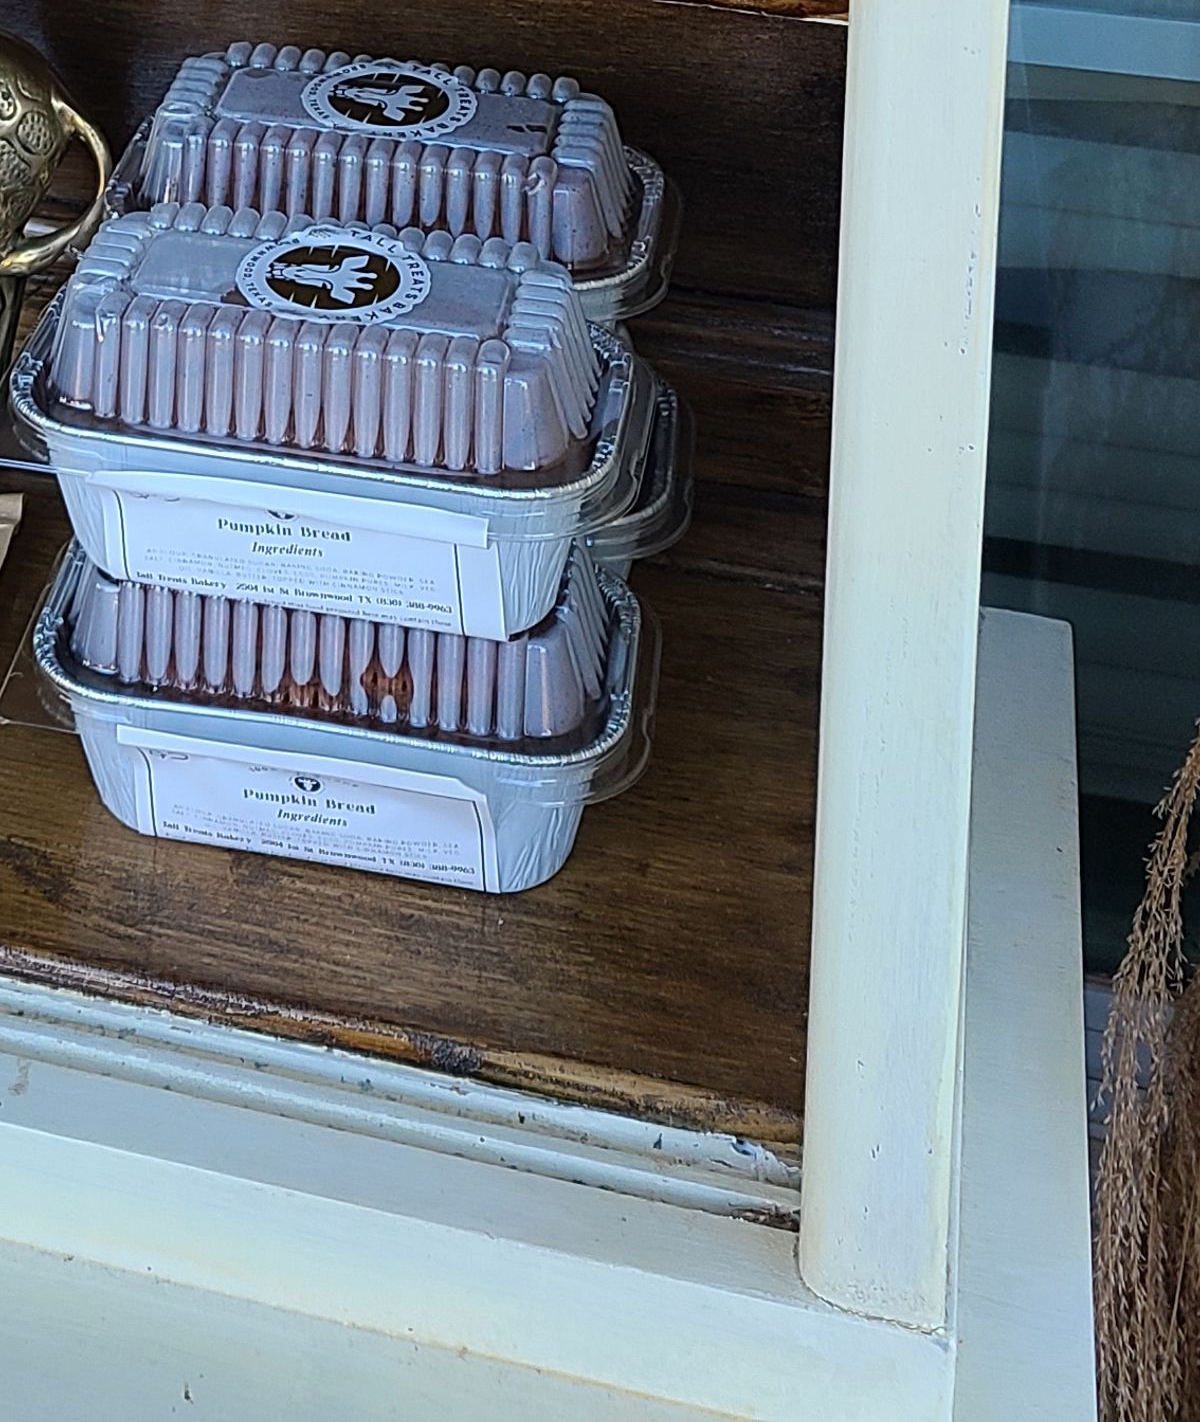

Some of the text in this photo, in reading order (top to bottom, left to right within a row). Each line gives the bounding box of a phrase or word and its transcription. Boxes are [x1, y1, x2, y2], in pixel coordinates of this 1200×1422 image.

[412, 65, 453, 86] TALL
[350, 230, 397, 254] TALL
[401, 255, 425, 300] TREATS
[245, 282, 273, 307] TEXAS
[217, 518, 352, 543] Pumpkin Bread
[252, 541, 324, 558] Ingredients
[190, 577, 227, 590] Bakery
[293, 588, 353, 604] Brownwood
[358, 595, 372, 604] TX
[243, 788, 376, 815] Pumpkin Bread
[277, 808, 348, 827] Ingredients
